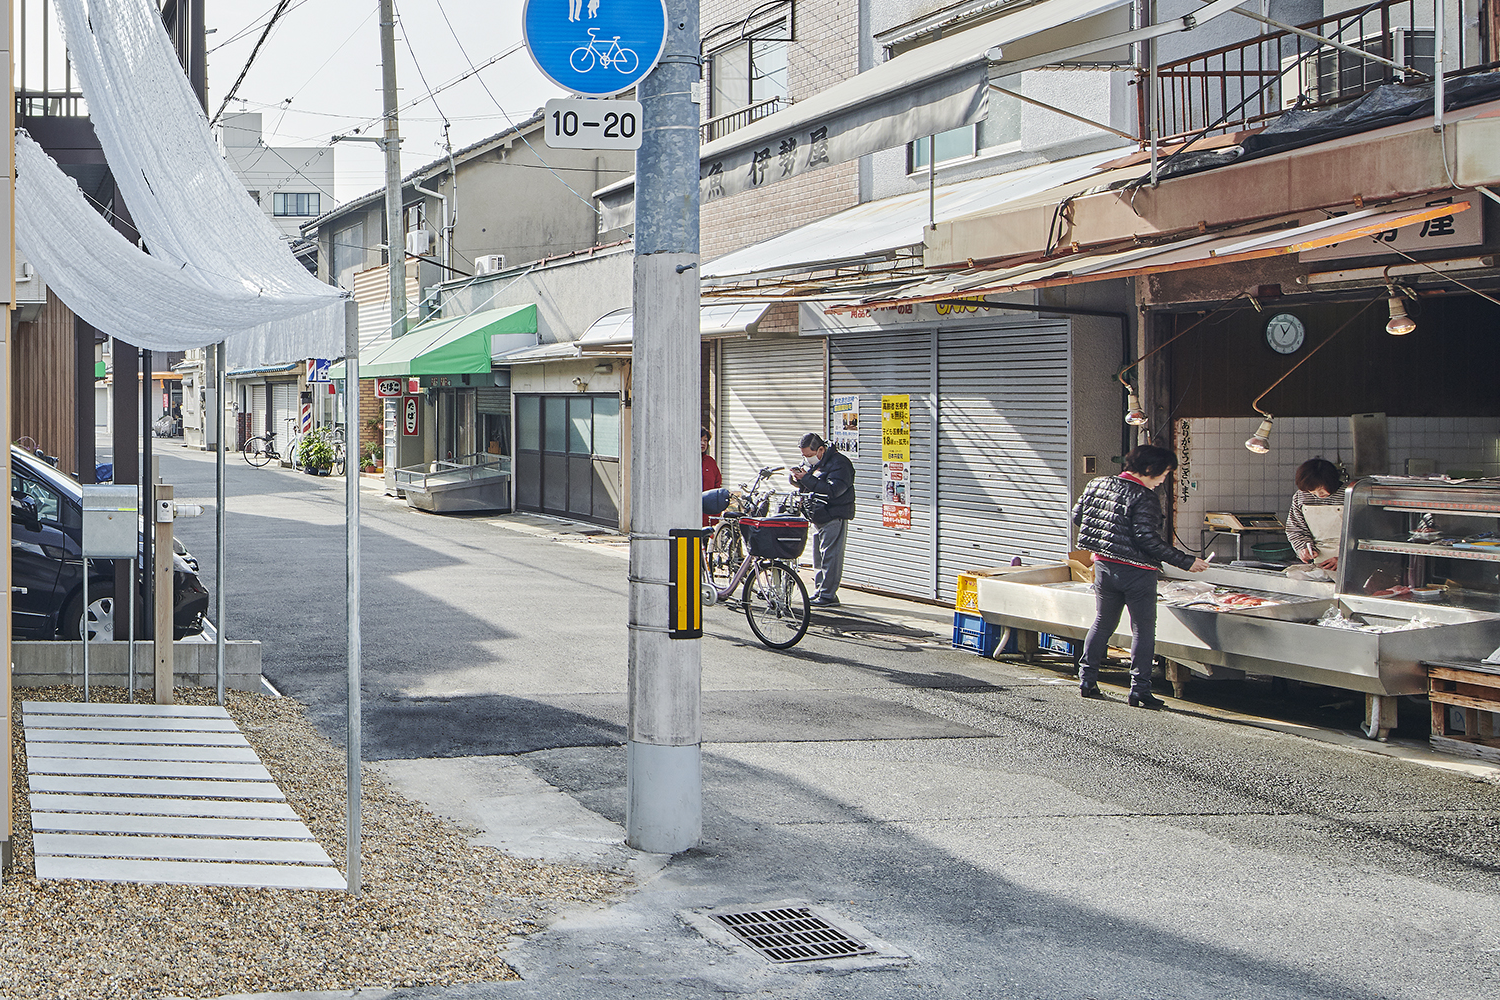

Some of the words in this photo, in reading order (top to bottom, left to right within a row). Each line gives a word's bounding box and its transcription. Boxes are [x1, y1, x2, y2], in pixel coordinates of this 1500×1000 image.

[747, 125, 830, 186] 伊勢屋
[380, 381, 400, 392] たばこ
[408, 402, 416, 429] たばこ
